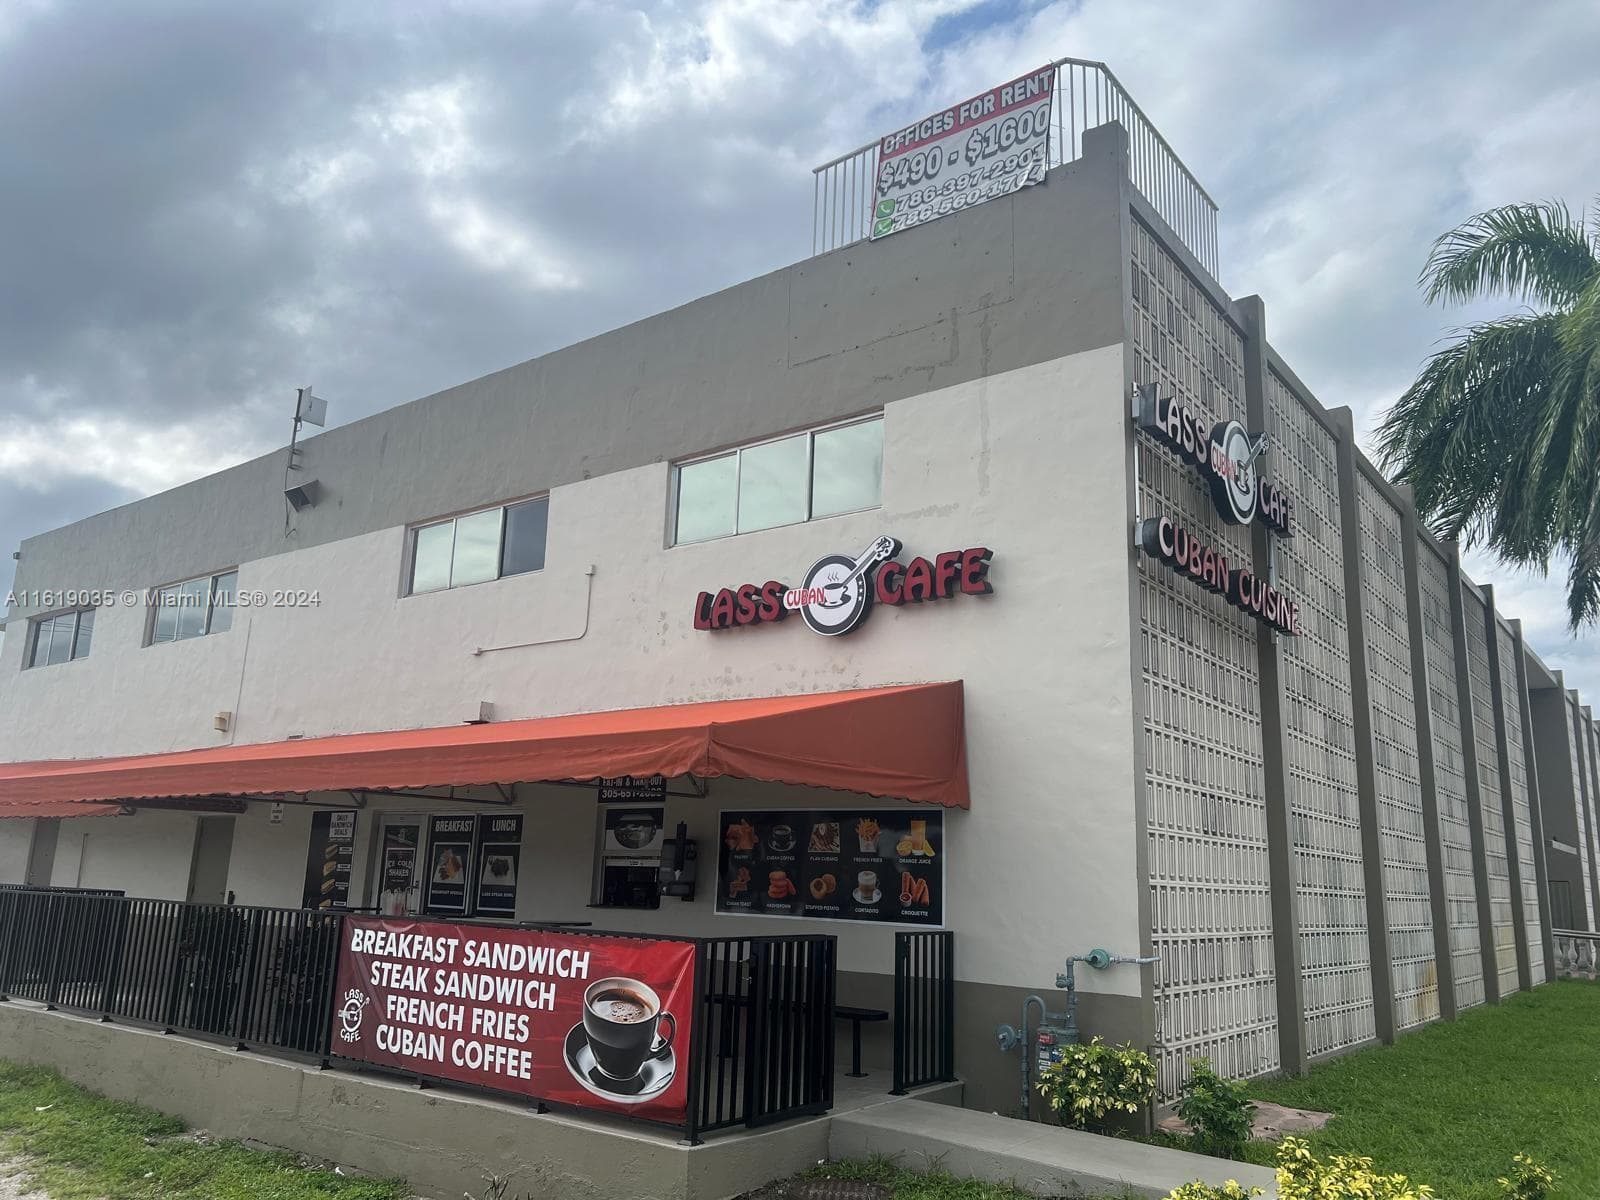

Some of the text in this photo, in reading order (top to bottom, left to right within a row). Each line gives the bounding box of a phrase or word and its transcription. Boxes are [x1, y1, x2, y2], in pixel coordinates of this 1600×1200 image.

[883, 69, 1052, 154] OFFICES FOR RENT
[879, 146, 943, 195] $490
[966, 103, 1050, 165] $1600
[895, 143, 1045, 211] 786-397-2901
[1155, 383, 1208, 464] LASS
[1211, 446, 1238, 481] CUBAN
[693, 547, 994, 631] LASS CUBAN CAFE
[1159, 516, 1301, 635] CUBAN CUISINE
[435, 819, 474, 832] BREAKFAST
[492, 819, 517, 832] LUNCH
[900, 909, 929, 917] CROQUETTE
[351, 927, 591, 980] BREAKFAST SANDWICH
[344, 988, 364, 1003] LASS
[370, 960, 557, 1011] STEAK SANDWICH
[340, 1028, 361, 1043] CAFE
[385, 994, 530, 1043] FRENCH FRIES
[375, 1023, 532, 1080] CUBAN COFFEE
